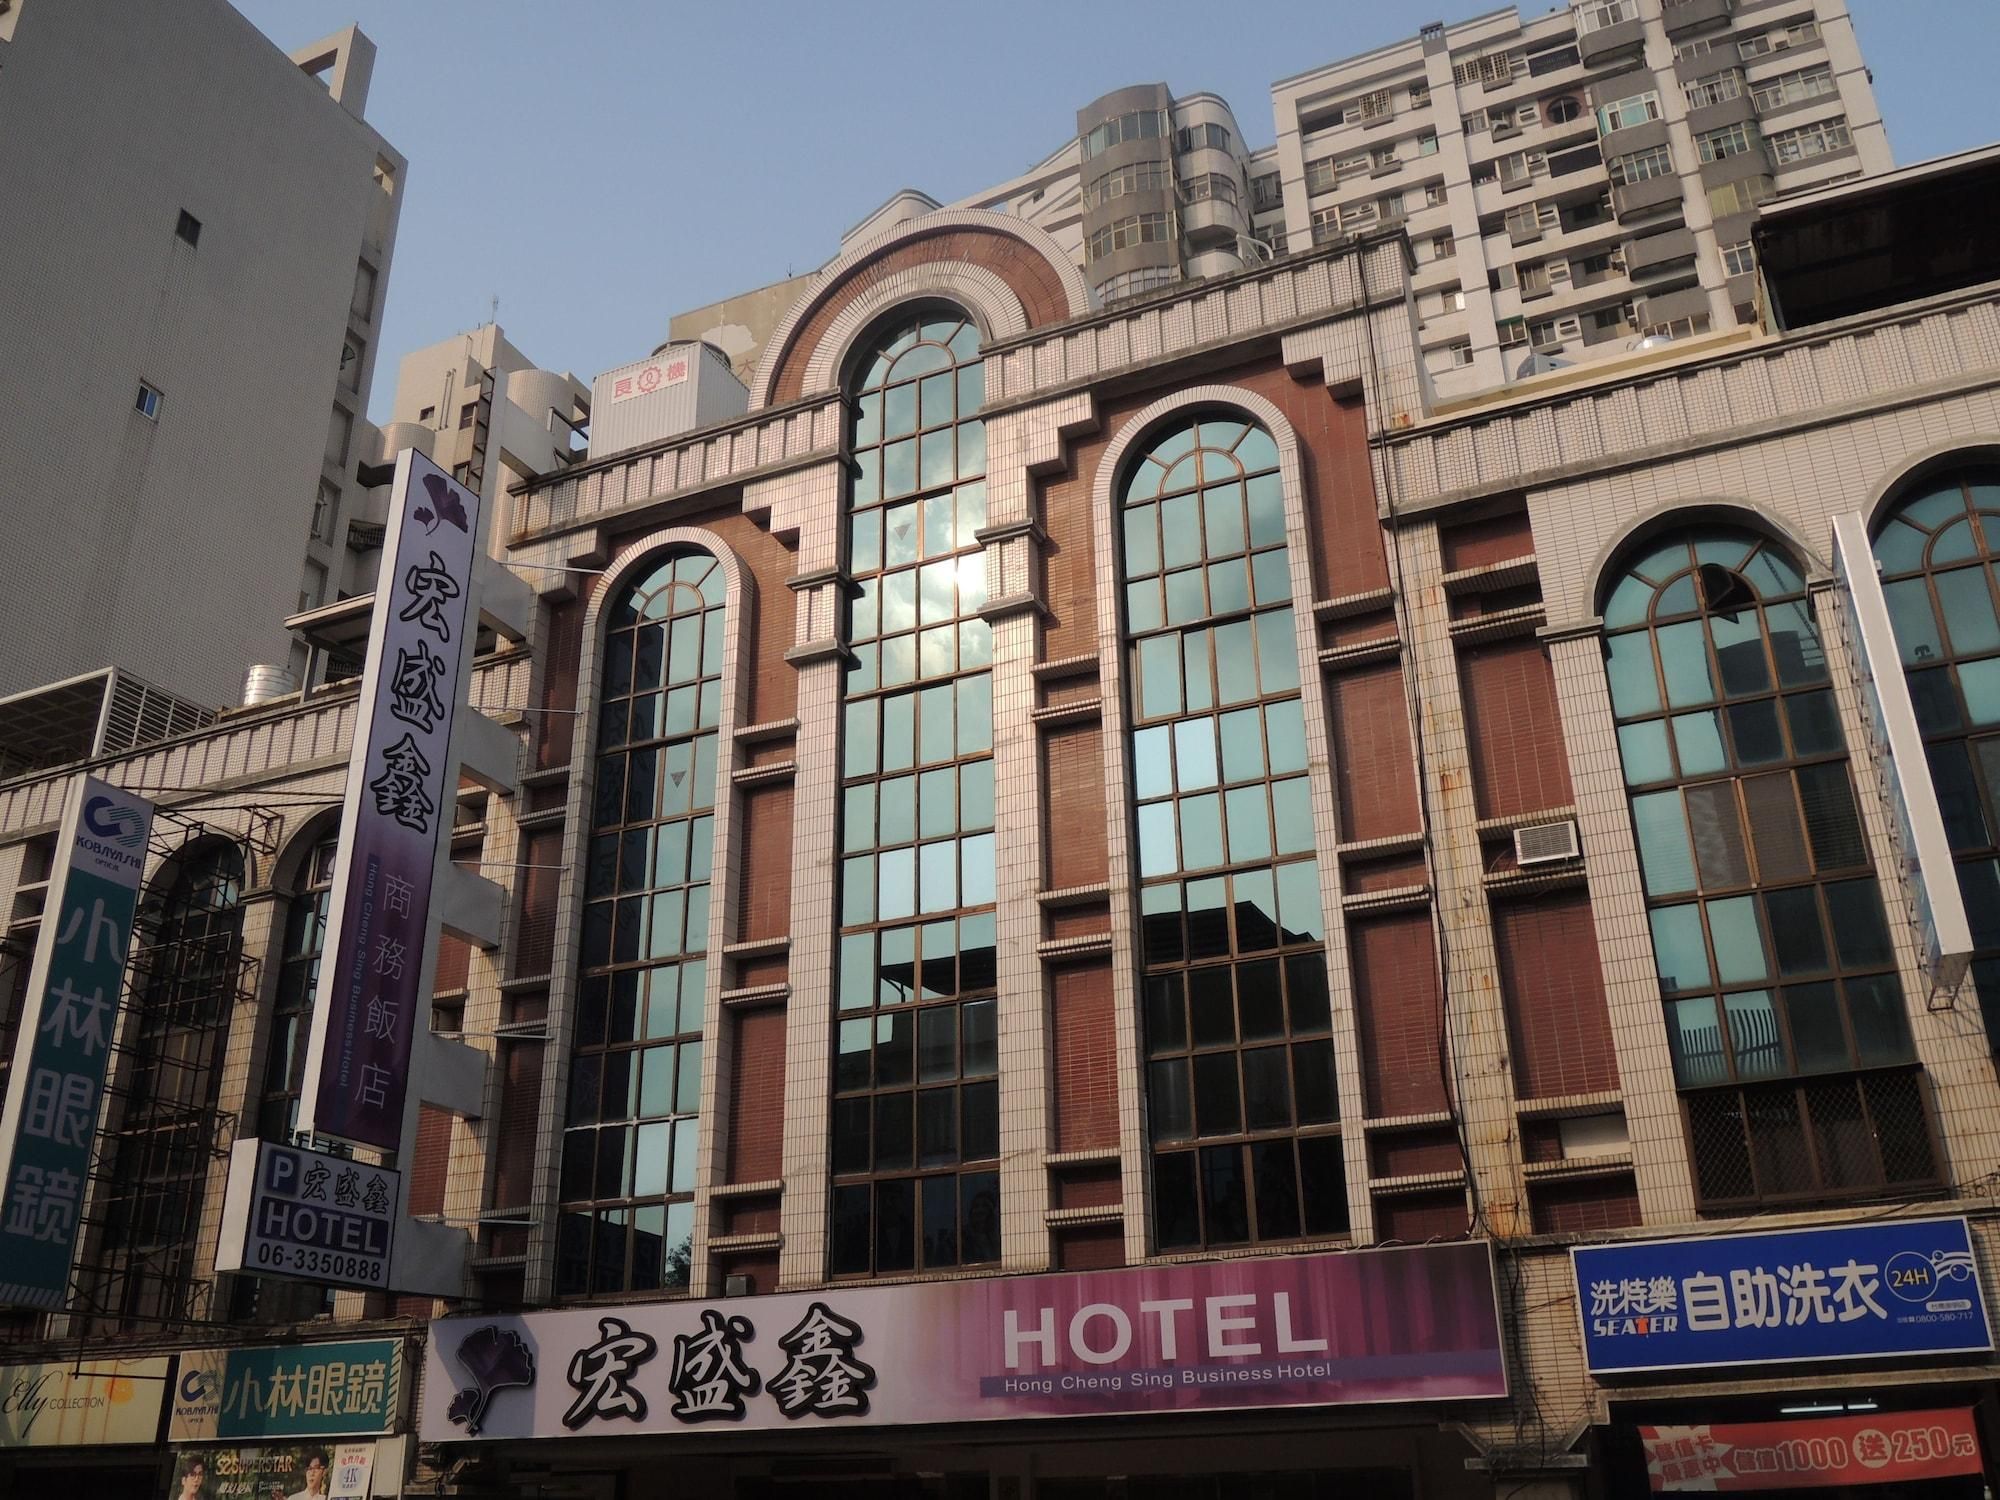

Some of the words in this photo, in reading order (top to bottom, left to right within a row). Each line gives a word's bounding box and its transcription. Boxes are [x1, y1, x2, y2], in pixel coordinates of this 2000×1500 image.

[370, 551, 460, 833] 宏盛鑫
[355, 875, 415, 1109] 商務飯店
[4, 898, 123, 1245] 小林眼鏡
[272, 1156, 294, 1189] P
[302, 1160, 390, 1214] 宏盛鑫
[265, 1201, 381, 1254] HOTEL
[258, 1243, 381, 1282] 06-3350888
[1891, 1267, 1930, 1287] 24H
[1590, 1275, 1678, 1315] 洗特樂
[1681, 1259, 1888, 1331] 自助洗衣
[1003, 1291, 1328, 1369] HOTEL
[223, 1359, 386, 1419] 小林眼鏡
[562, 1302, 876, 1431] 宏盛鑫
[1005, 1377, 1053, 1394] Hong
[1061, 1374, 1122, 1391] Cheng
[1131, 1370, 1174, 1389] Sing
[1182, 1366, 1273, 1385] Business
[1278, 1361, 1332, 1379] Hotel
[2, 1370, 63, 1438] Elly
[50, 1397, 105, 1410] COLLECTION
